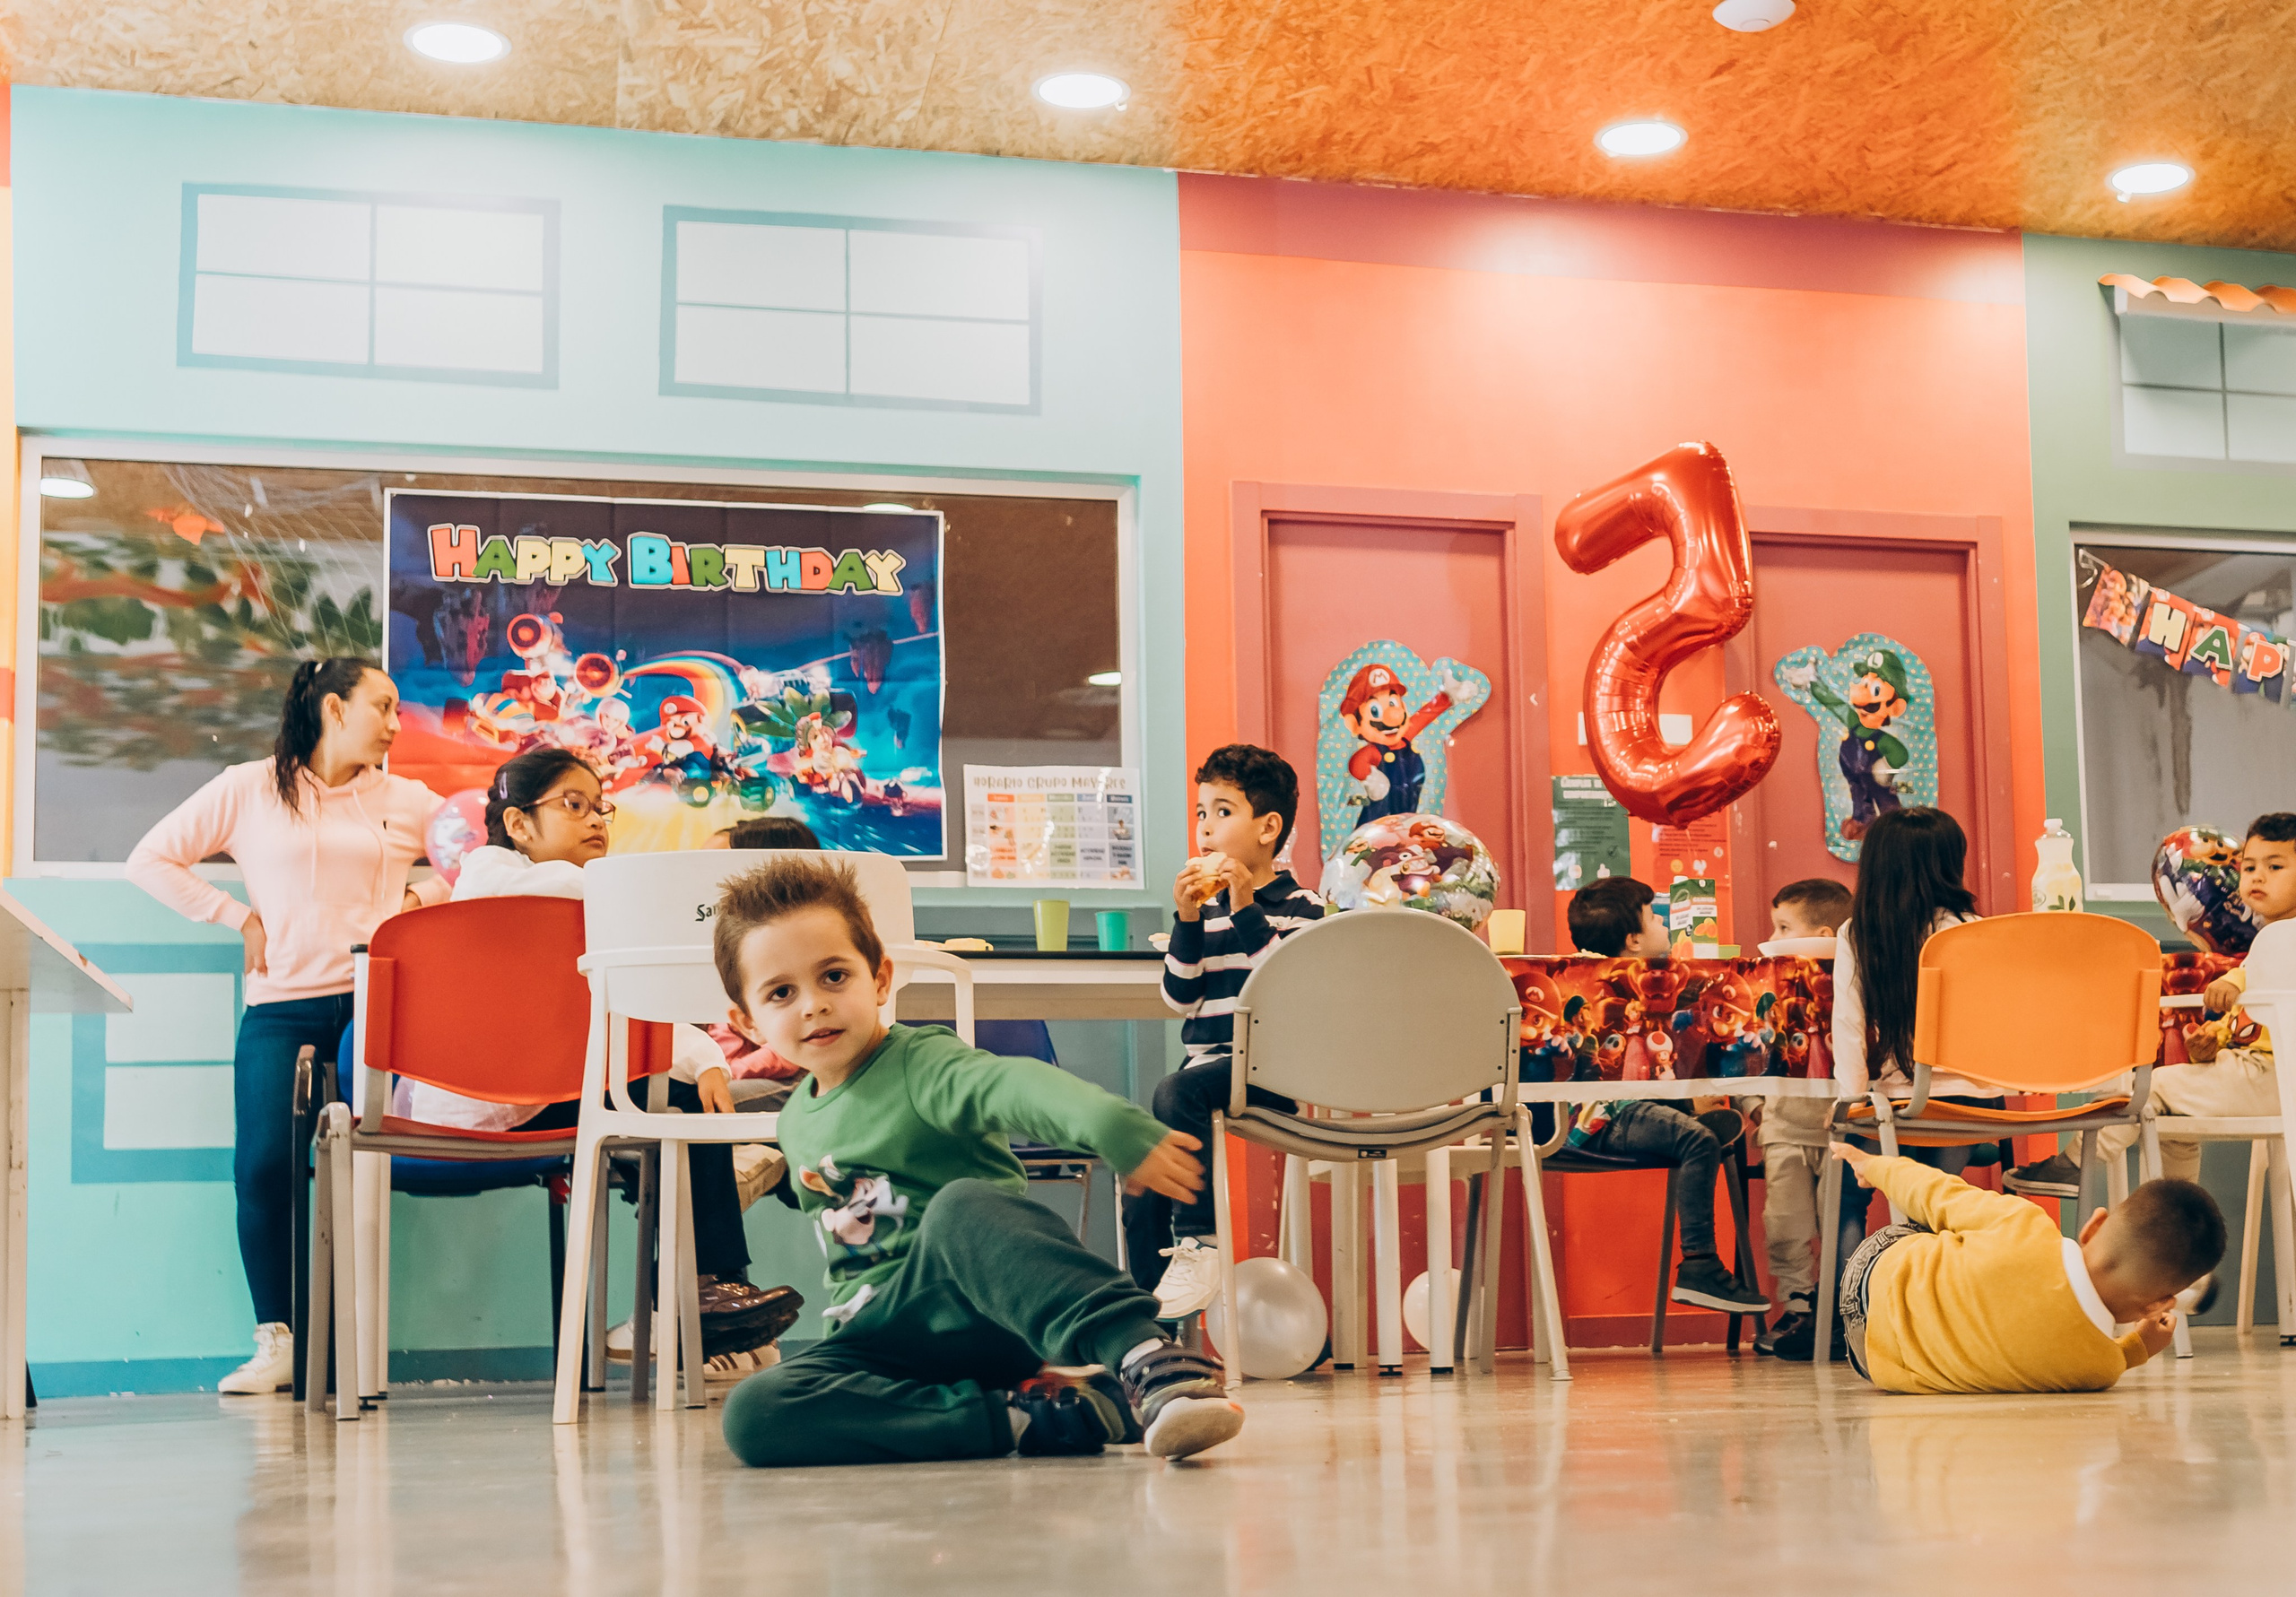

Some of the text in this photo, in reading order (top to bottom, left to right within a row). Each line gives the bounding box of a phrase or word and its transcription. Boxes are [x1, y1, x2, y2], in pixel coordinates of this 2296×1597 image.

[427, 523, 907, 596] HAPPY BIRTHDAY
[974, 777, 1126, 790] HORARIO GRUPO MAYRES
[695, 904, 717, 922] Sa
